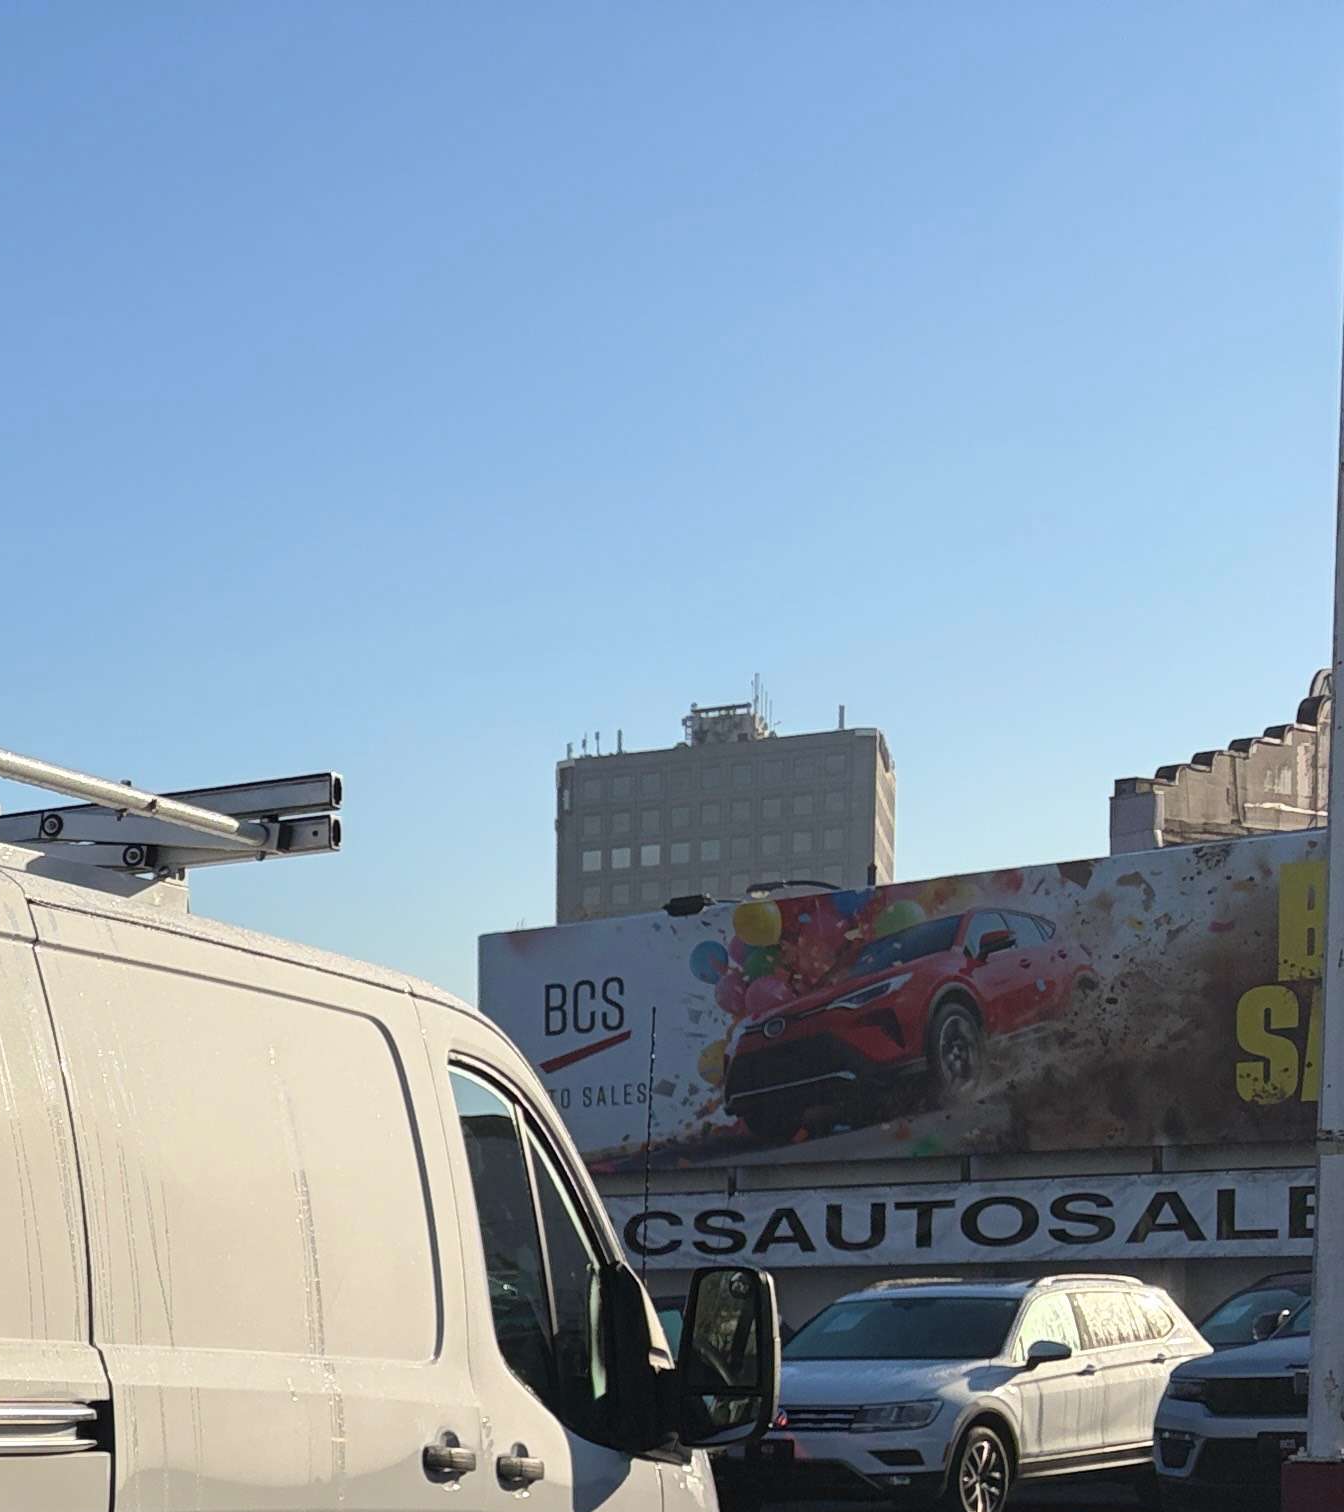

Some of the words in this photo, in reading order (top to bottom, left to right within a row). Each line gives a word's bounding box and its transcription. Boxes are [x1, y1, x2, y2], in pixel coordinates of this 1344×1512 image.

[544, 976, 625, 1036] BCS
[1235, 984, 1324, 1105] S
[548, 1088, 571, 1109] TO
[582, 1082, 648, 1108] SALES
